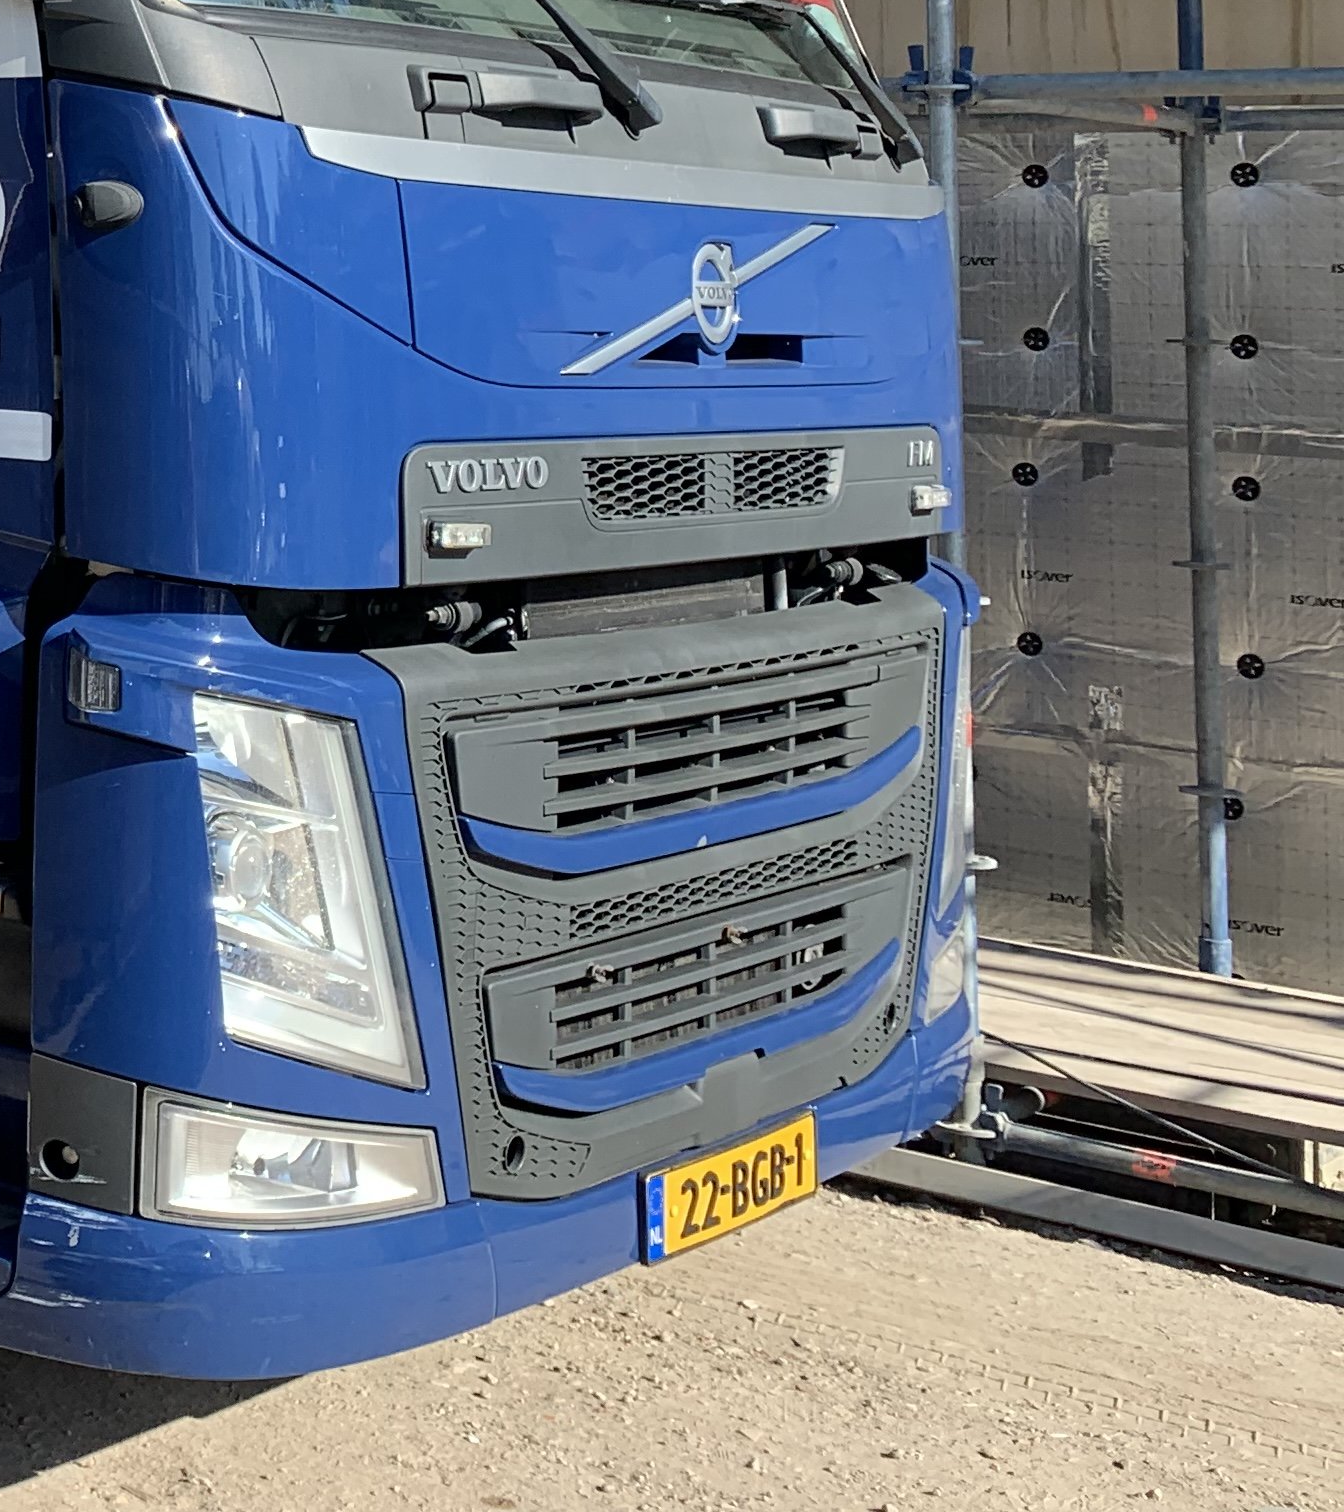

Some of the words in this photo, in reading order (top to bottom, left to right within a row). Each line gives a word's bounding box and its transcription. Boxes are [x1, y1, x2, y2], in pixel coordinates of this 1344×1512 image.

[695, 286, 734, 300] VOLV
[907, 439, 934, 467] FM
[425, 455, 550, 494] VOLVO
[680, 1132, 804, 1240] 22-BGB-1
[649, 1226, 664, 1247] NL
